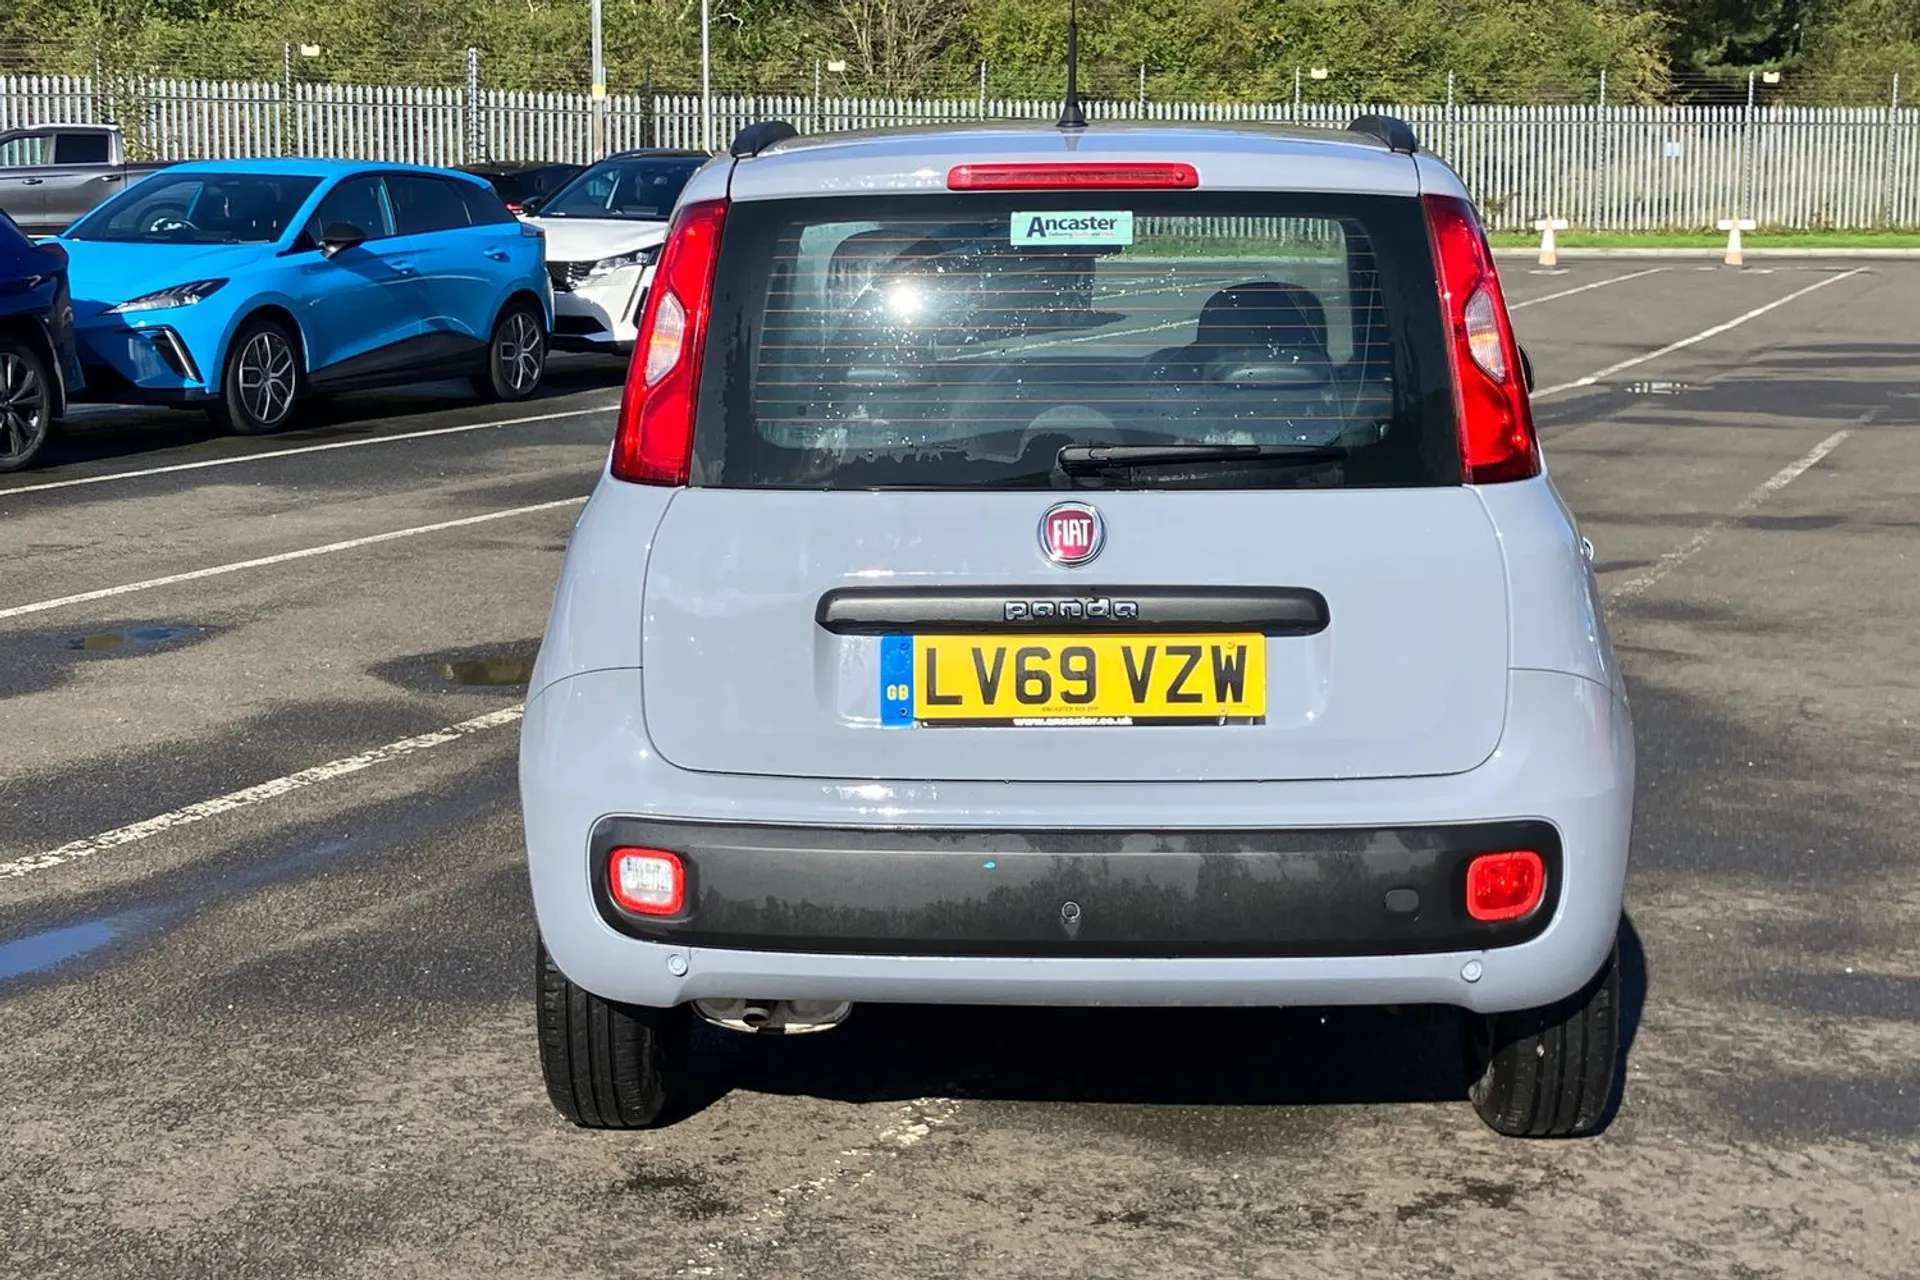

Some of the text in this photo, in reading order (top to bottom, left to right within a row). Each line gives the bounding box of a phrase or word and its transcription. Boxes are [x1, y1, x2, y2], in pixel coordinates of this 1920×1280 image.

[1026, 216, 1118, 238] Ancaster
[1053, 519, 1091, 547] FIAT
[1004, 597, 1139, 621] panda
[926, 645, 1248, 705] LV69 VZW
[886, 684, 909, 701] GB
